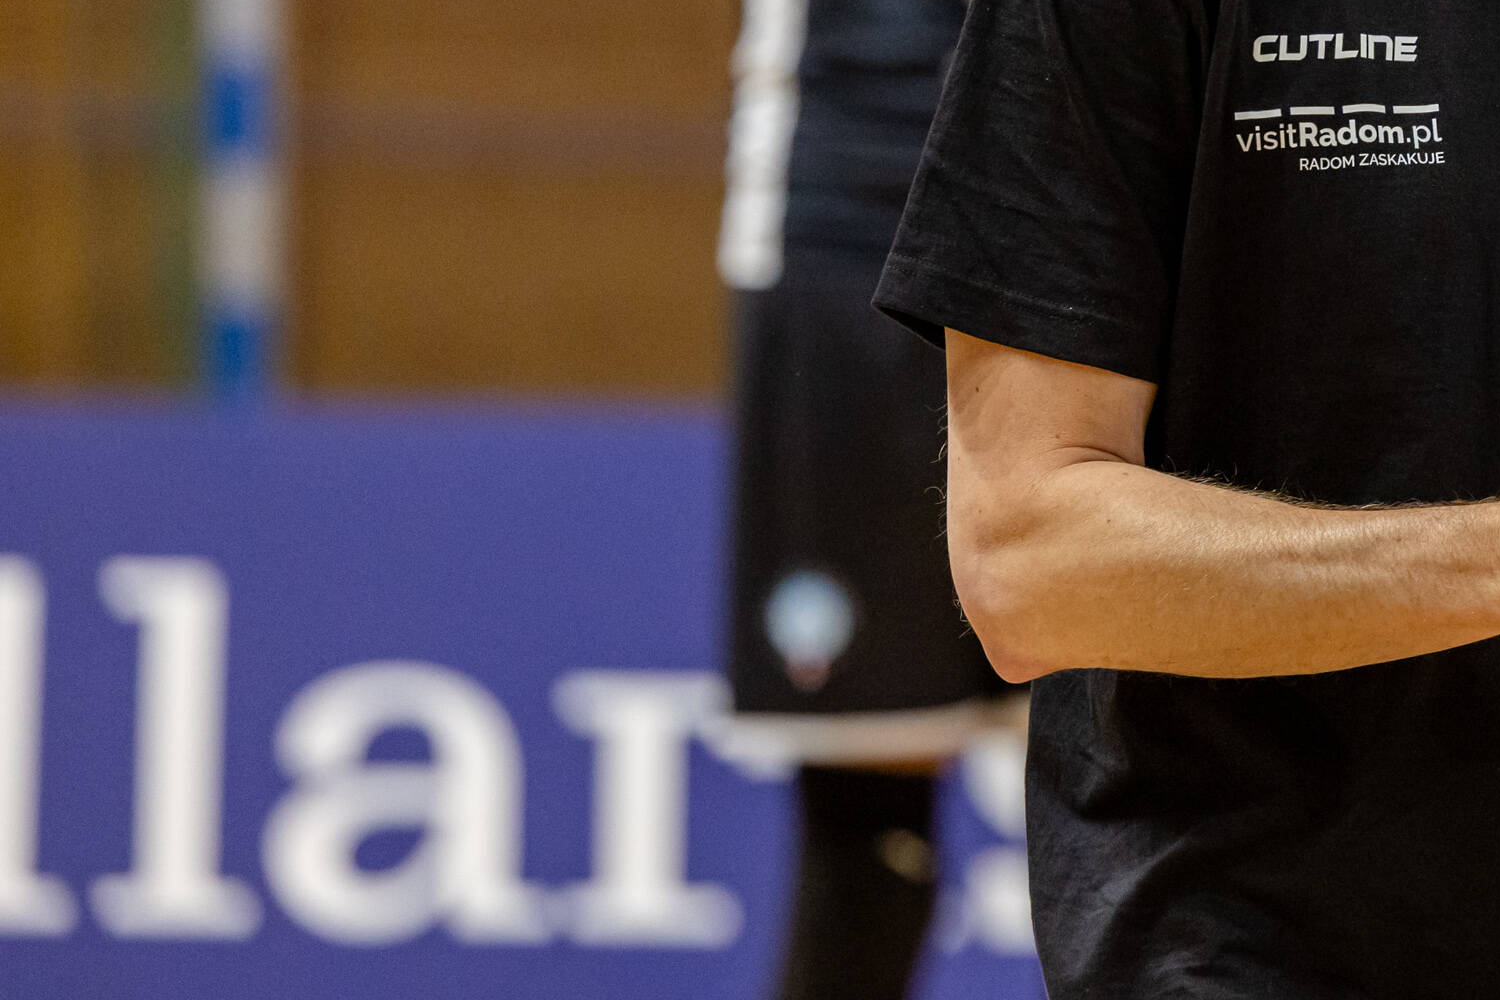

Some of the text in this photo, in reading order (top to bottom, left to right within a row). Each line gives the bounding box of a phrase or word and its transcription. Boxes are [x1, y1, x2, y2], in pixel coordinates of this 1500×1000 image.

[1252, 32, 1419, 62] CUTLINE
[1236, 117, 1443, 152] visitRadom.pl
[1299, 151, 1446, 171] RADOM ZASKAKUJE
